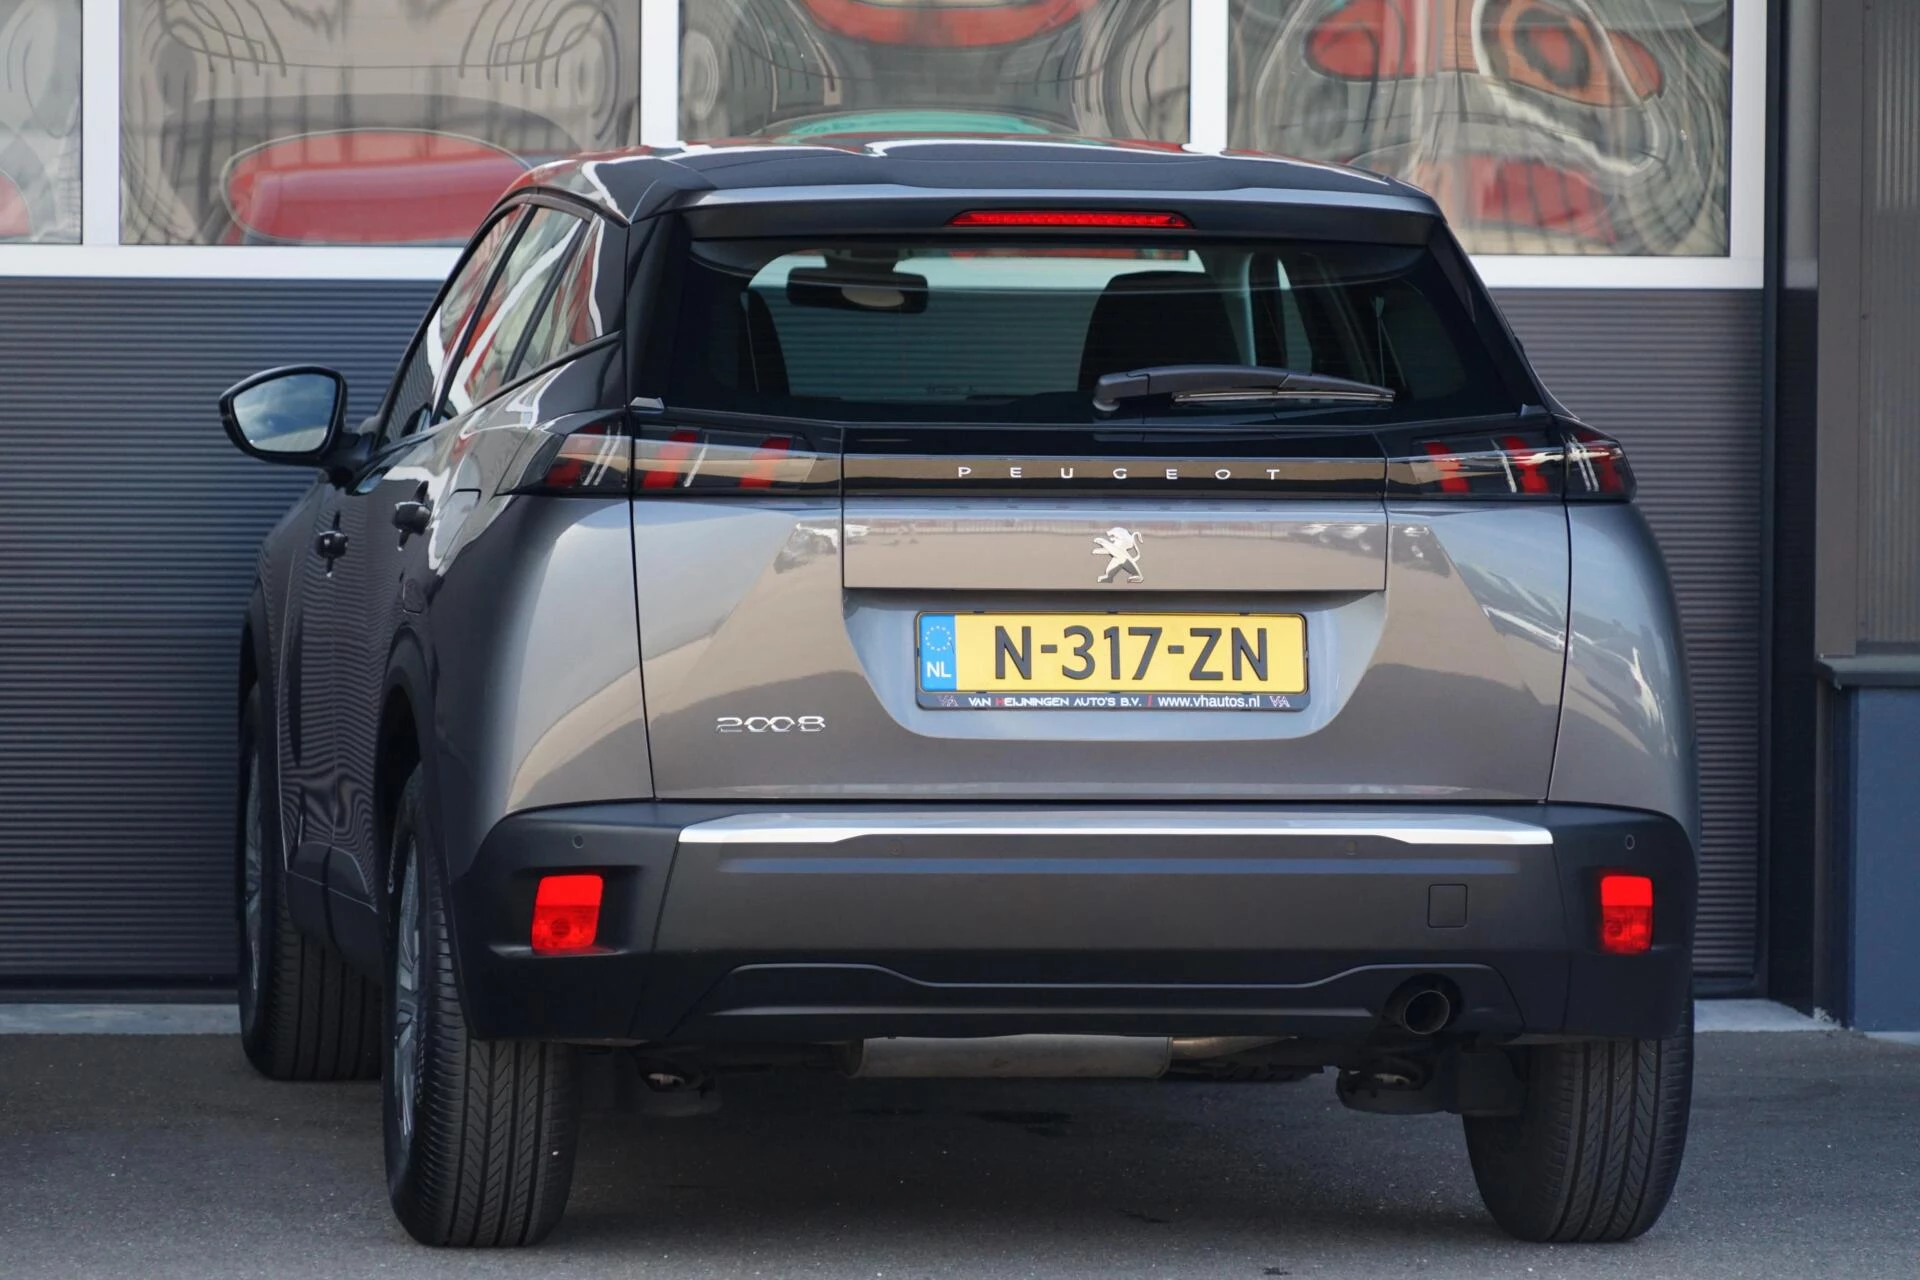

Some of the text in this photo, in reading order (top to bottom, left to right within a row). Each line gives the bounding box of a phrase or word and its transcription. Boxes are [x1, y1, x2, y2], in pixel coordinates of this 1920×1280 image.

[957, 466, 1280, 480] PEUGEOT
[995, 625, 1268, 681] N-317-ZN
[926, 661, 951, 678] NL
[968, 697, 991, 707] VAN
[1073, 697, 1116, 707] AUTO'S
[1157, 695, 1260, 708] www.vhautos.nl
[715, 716, 826, 733] 2008
